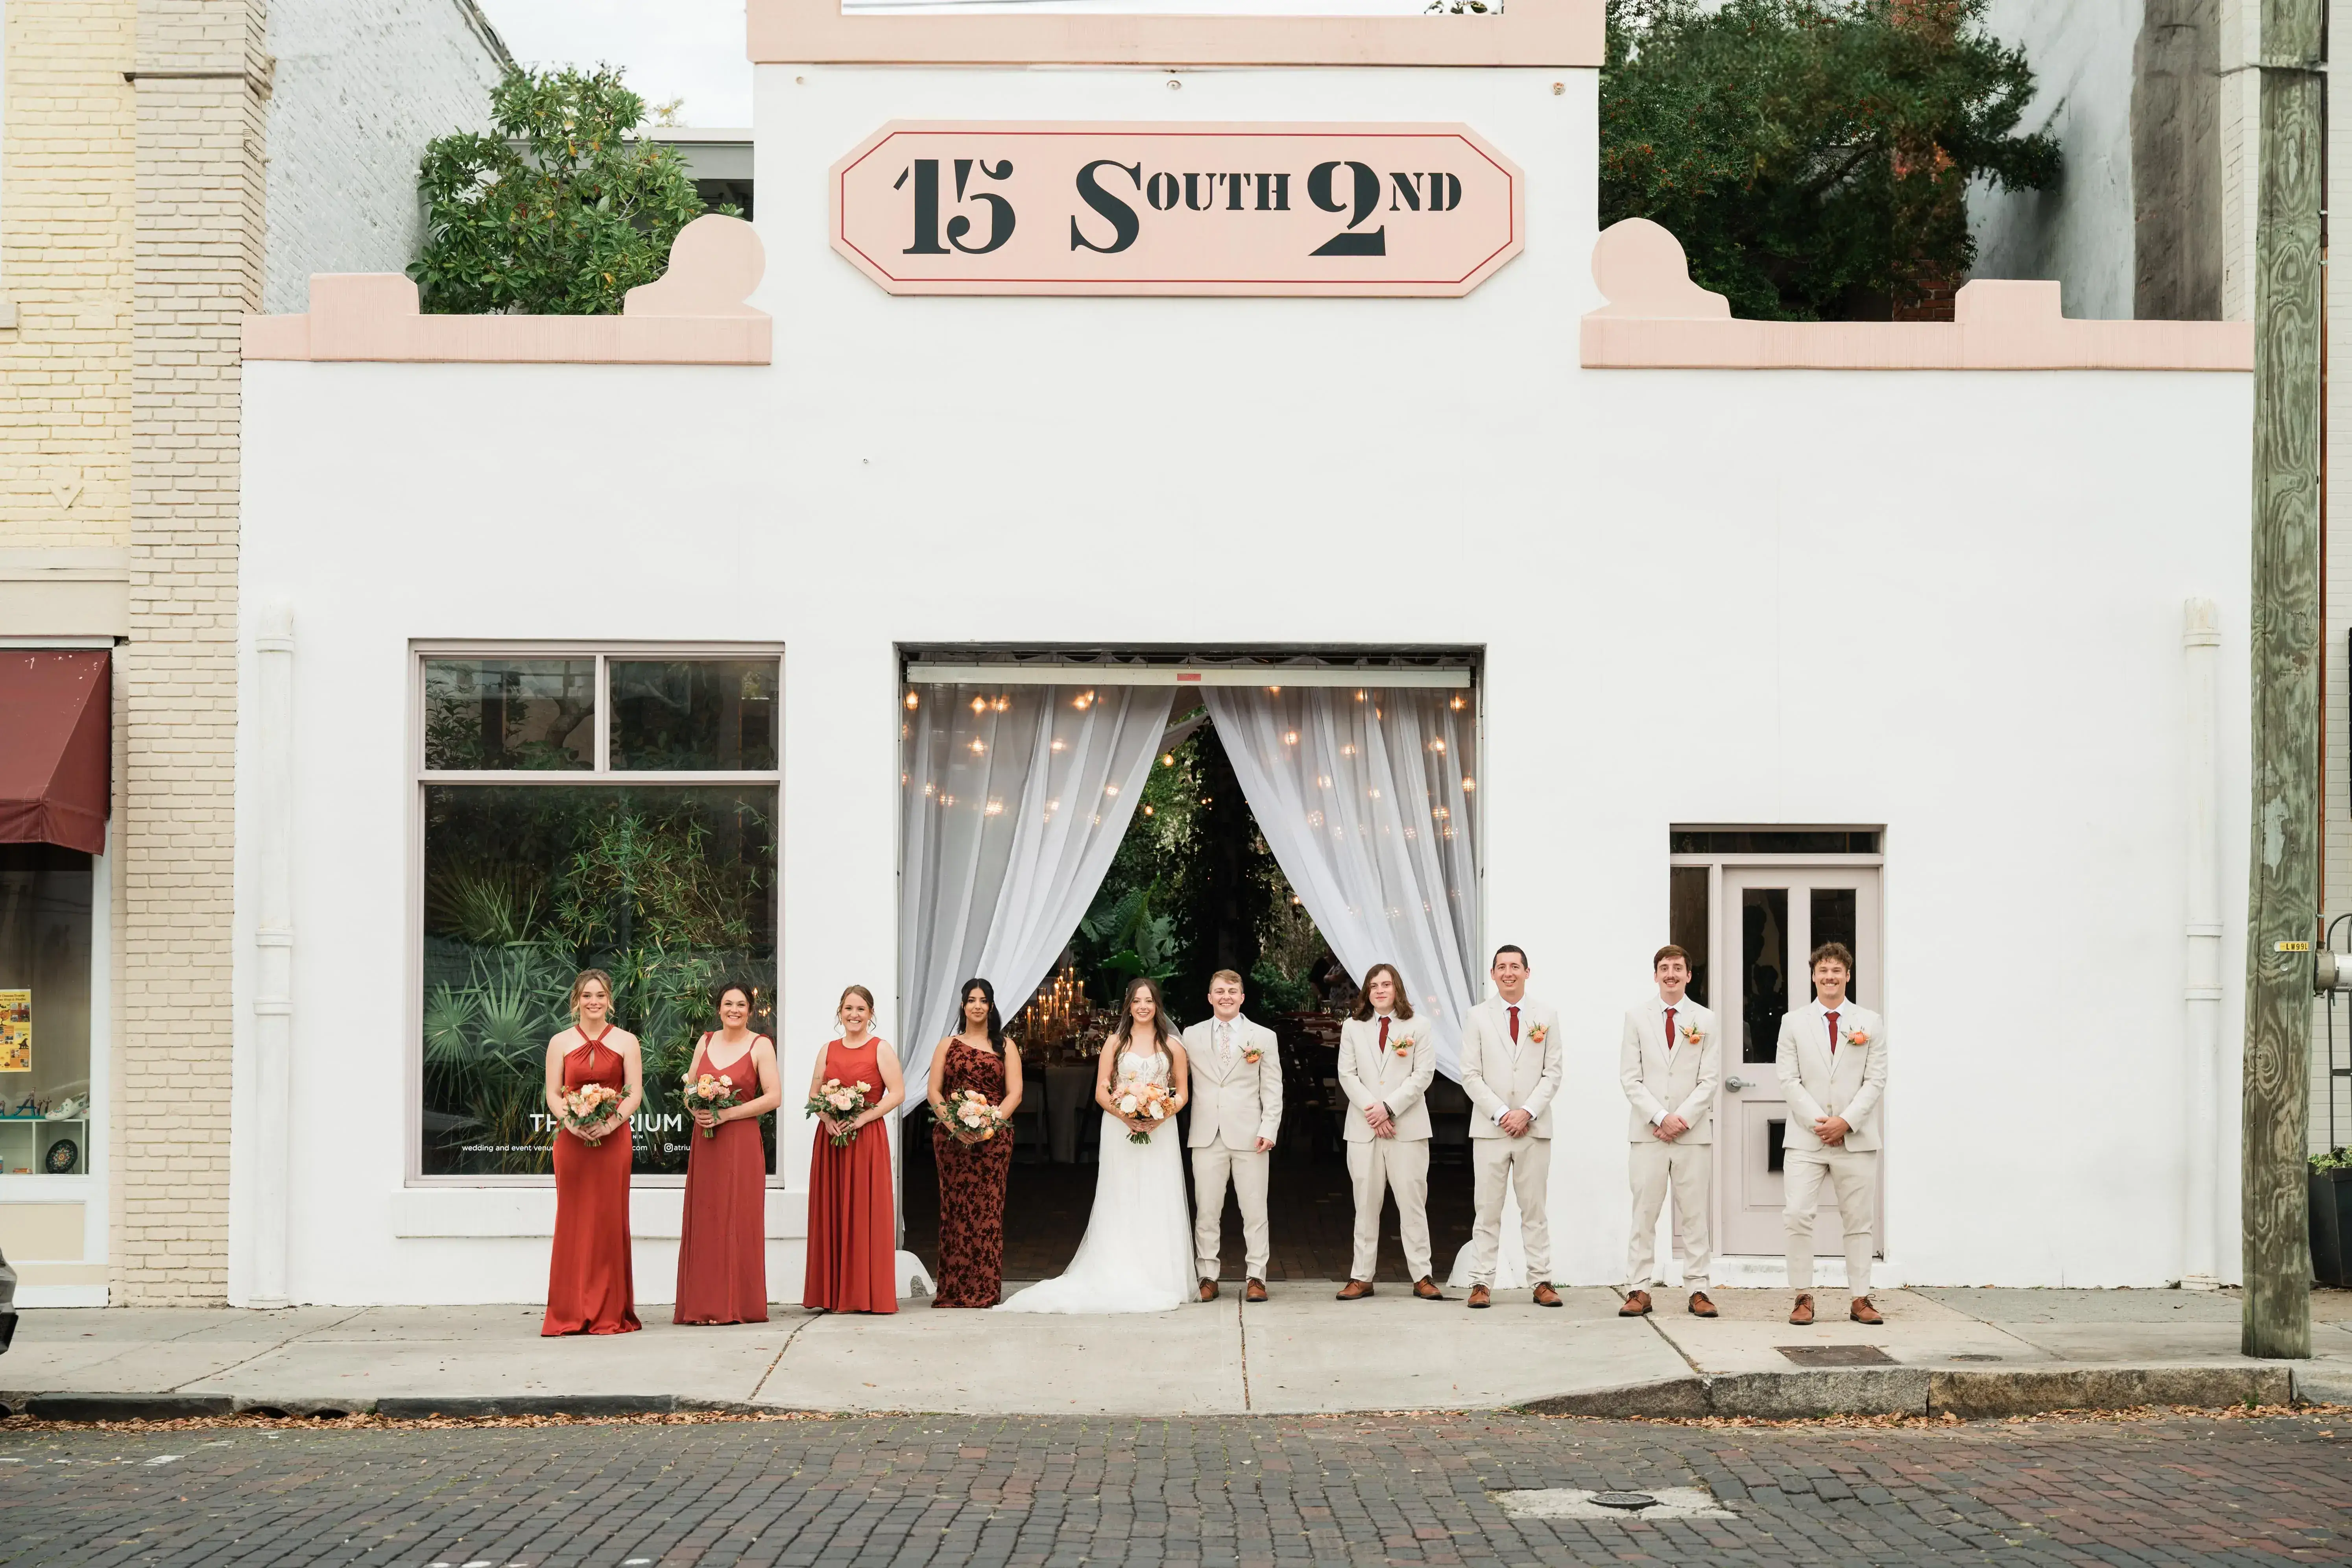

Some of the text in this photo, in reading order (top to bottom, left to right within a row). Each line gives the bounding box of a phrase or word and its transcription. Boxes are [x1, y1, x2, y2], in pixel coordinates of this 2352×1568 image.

[893, 159, 1016, 255] 15
[530, 1114, 681, 1132] TH RIUM
